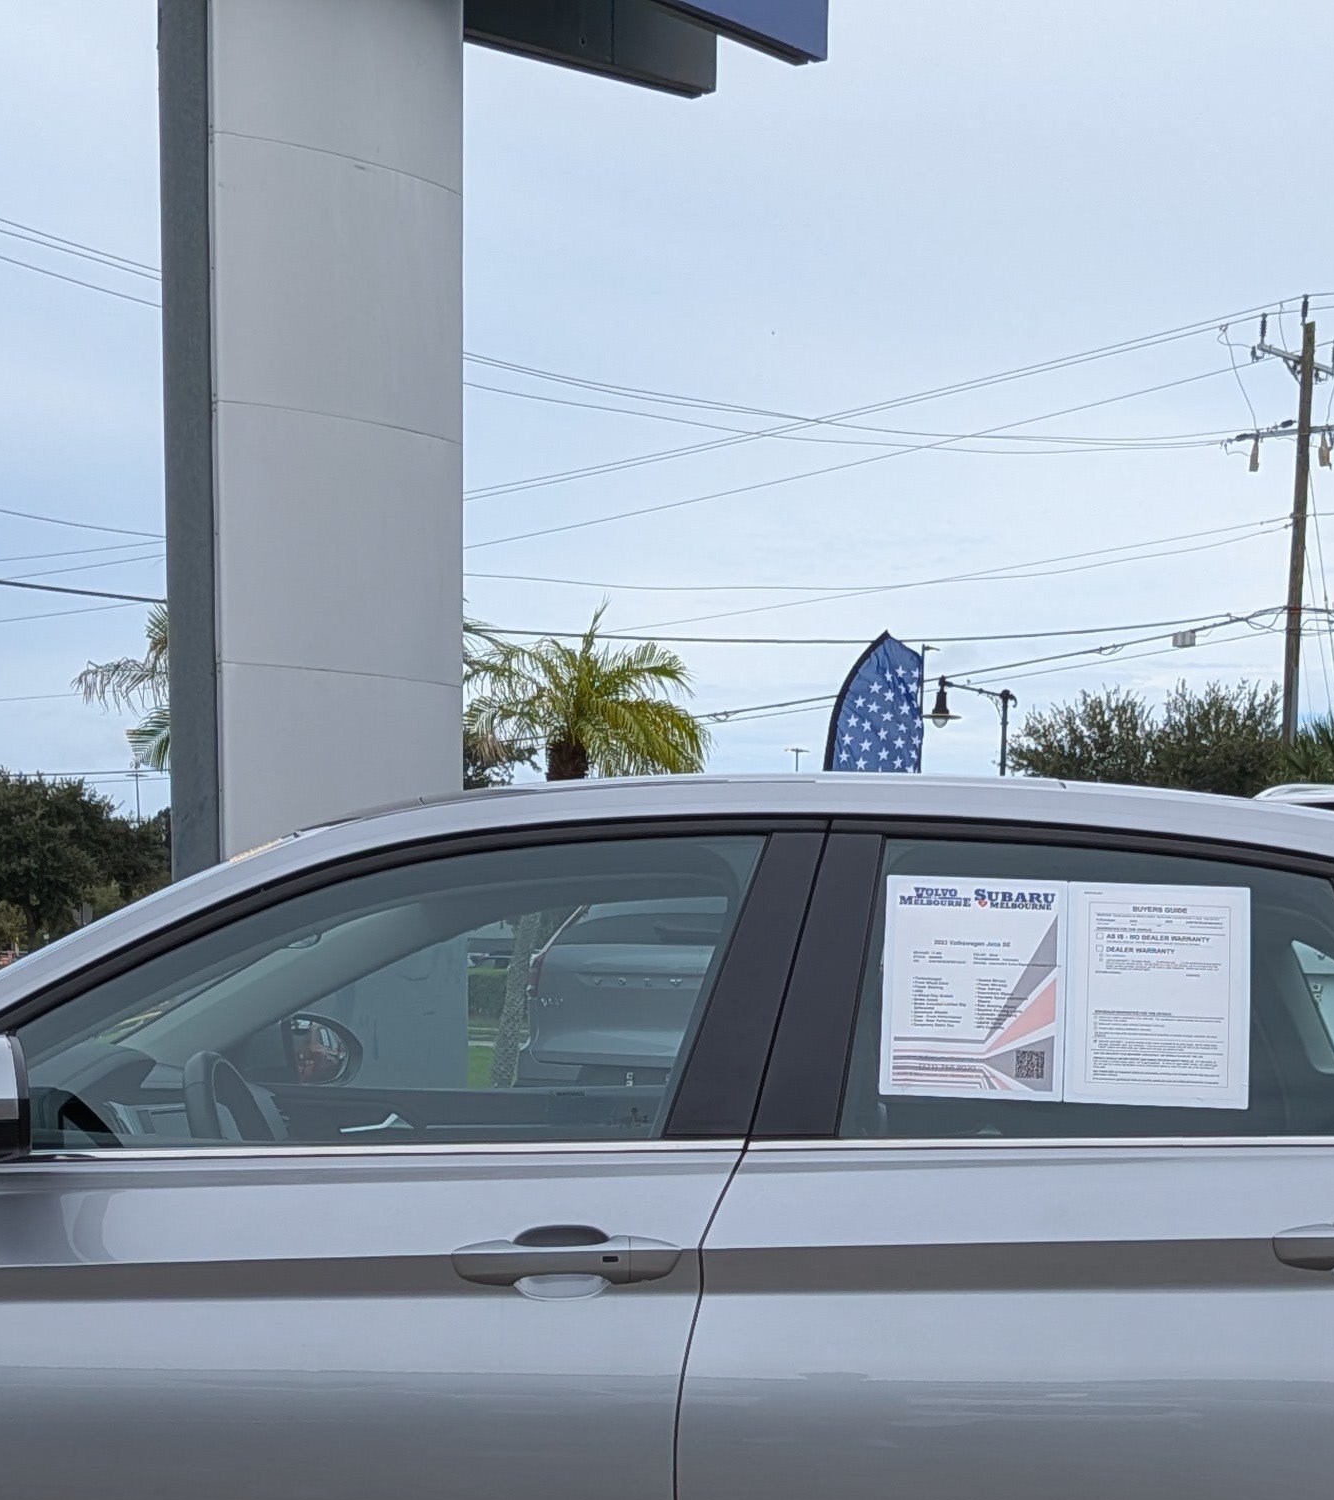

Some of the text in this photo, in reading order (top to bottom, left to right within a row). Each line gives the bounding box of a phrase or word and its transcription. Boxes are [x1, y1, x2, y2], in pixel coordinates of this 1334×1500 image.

[913, 886, 958, 898] VOLVO
[974, 888, 1056, 904] SUBARU
[899, 895, 971, 907] MELBOURNE
[990, 900, 1052, 910] MELBOURNE
[1135, 947, 1175, 955] WARRANTY
